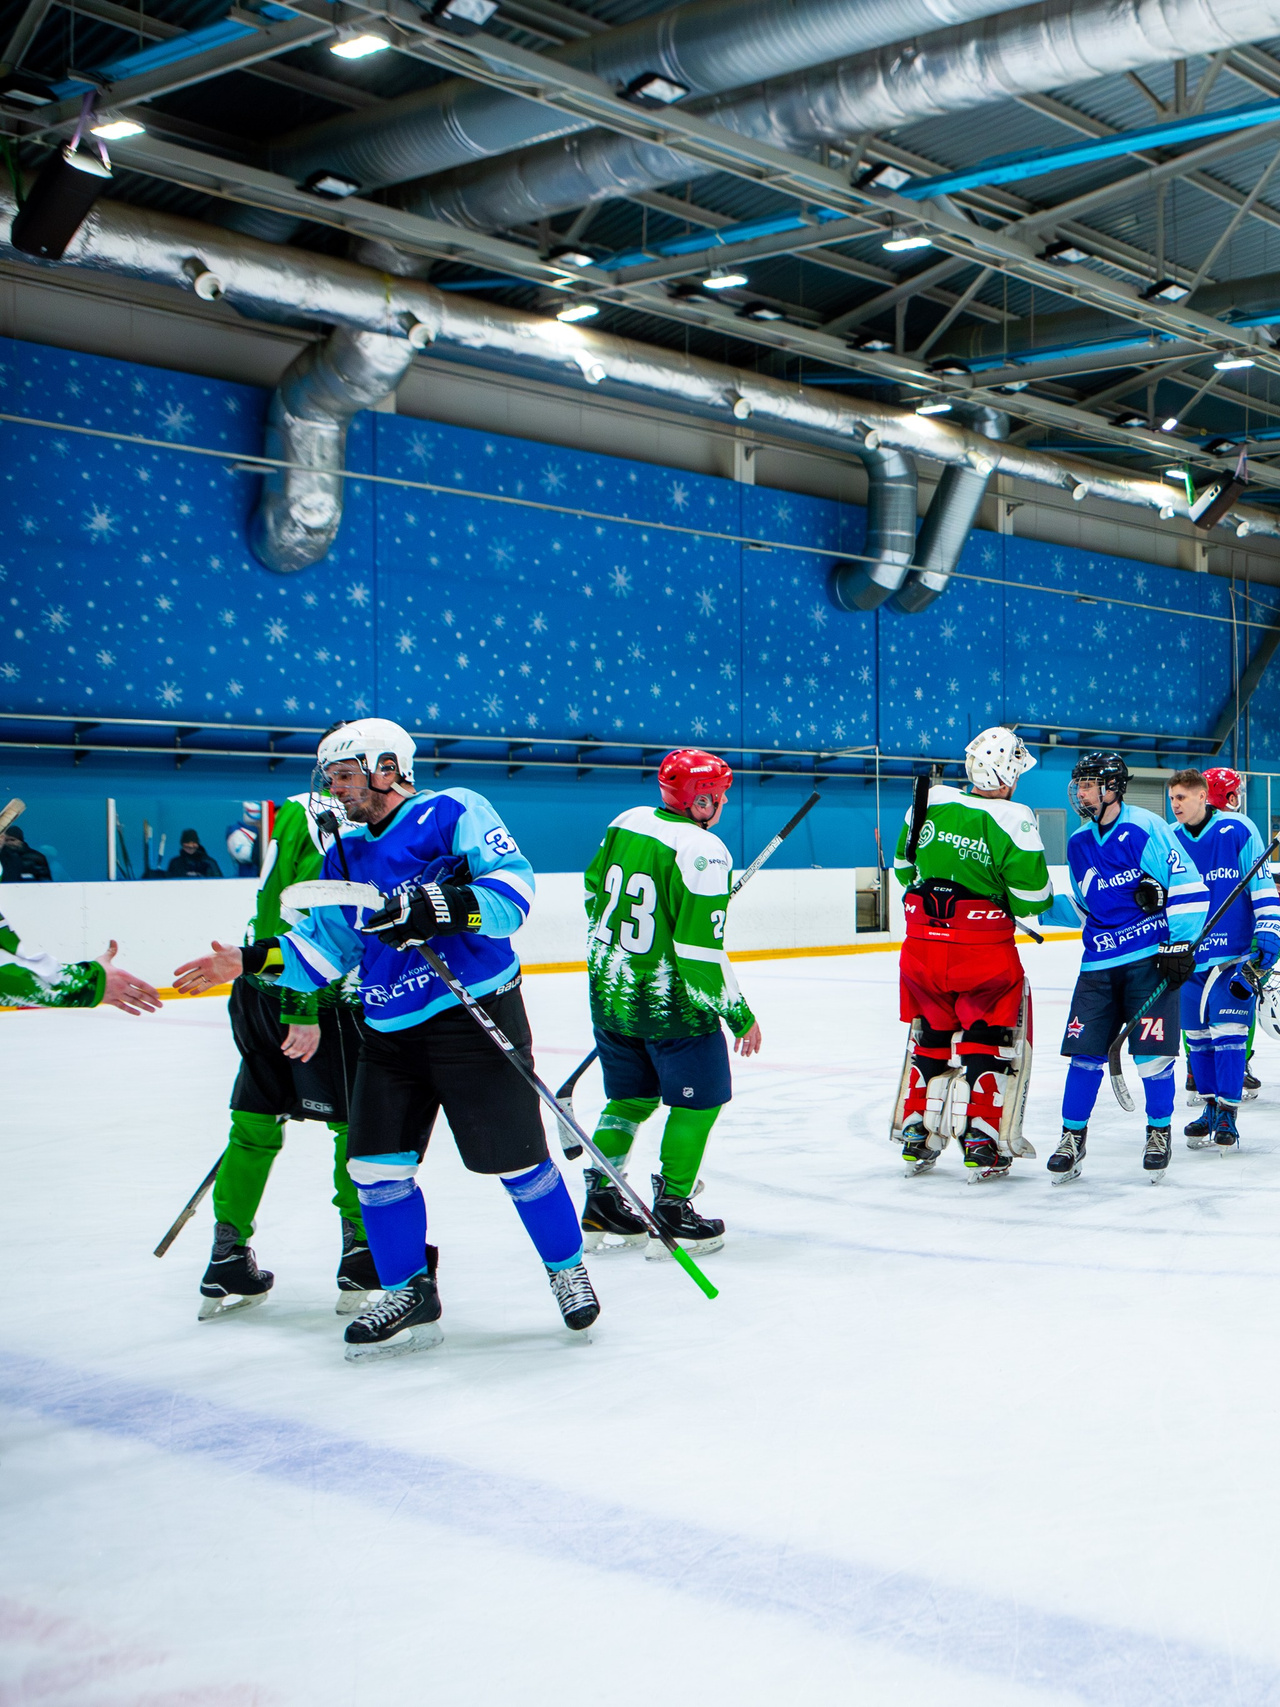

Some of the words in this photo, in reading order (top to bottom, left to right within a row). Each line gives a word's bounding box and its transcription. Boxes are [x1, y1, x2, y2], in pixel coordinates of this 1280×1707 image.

[594, 863, 657, 955] 23
[1118, 918, 1168, 945] АСТРУМ
[1139, 1017, 1164, 1042] 74
